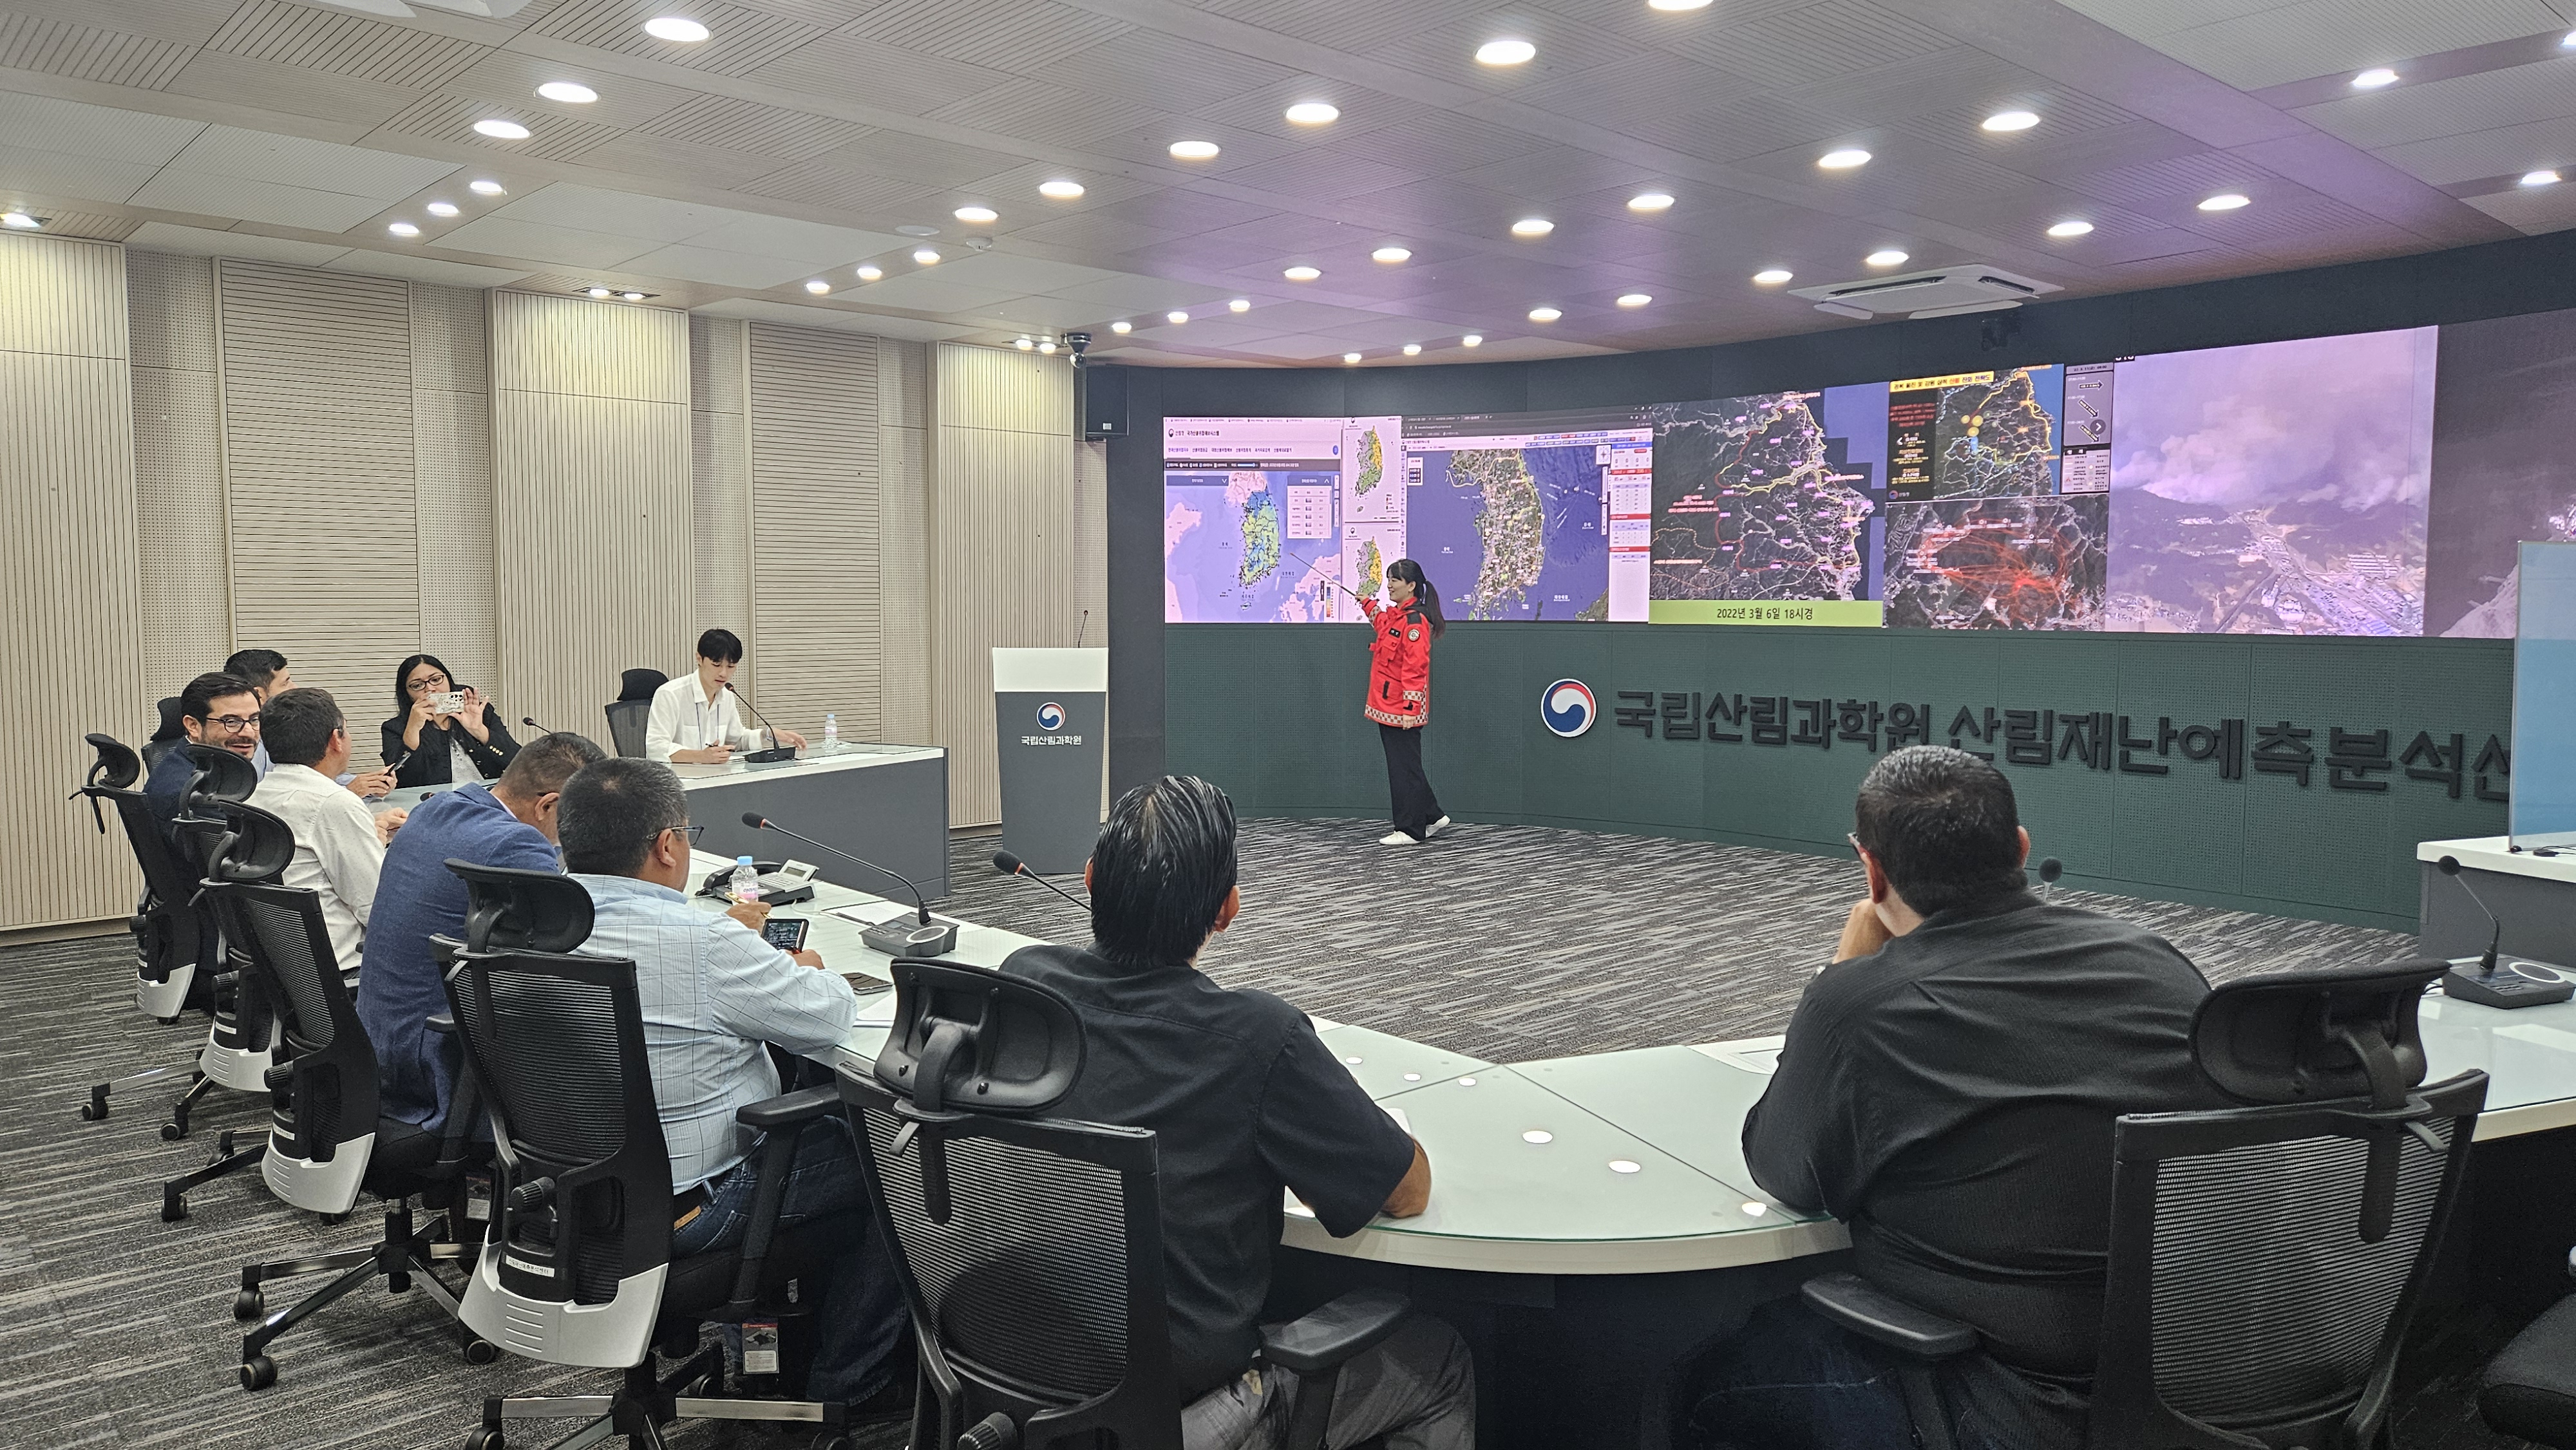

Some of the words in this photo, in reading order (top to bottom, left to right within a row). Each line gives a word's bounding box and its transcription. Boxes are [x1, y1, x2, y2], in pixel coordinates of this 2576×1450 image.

[1717, 607, 1746, 619] 2022년
[1749, 607, 1763, 619] 3월
[1766, 607, 1780, 619] 6일
[1785, 607, 1813, 620] 18시경
[1615, 690, 1931, 753] 국립산림과학원
[1021, 735, 1082, 746] 국립산림과학원
